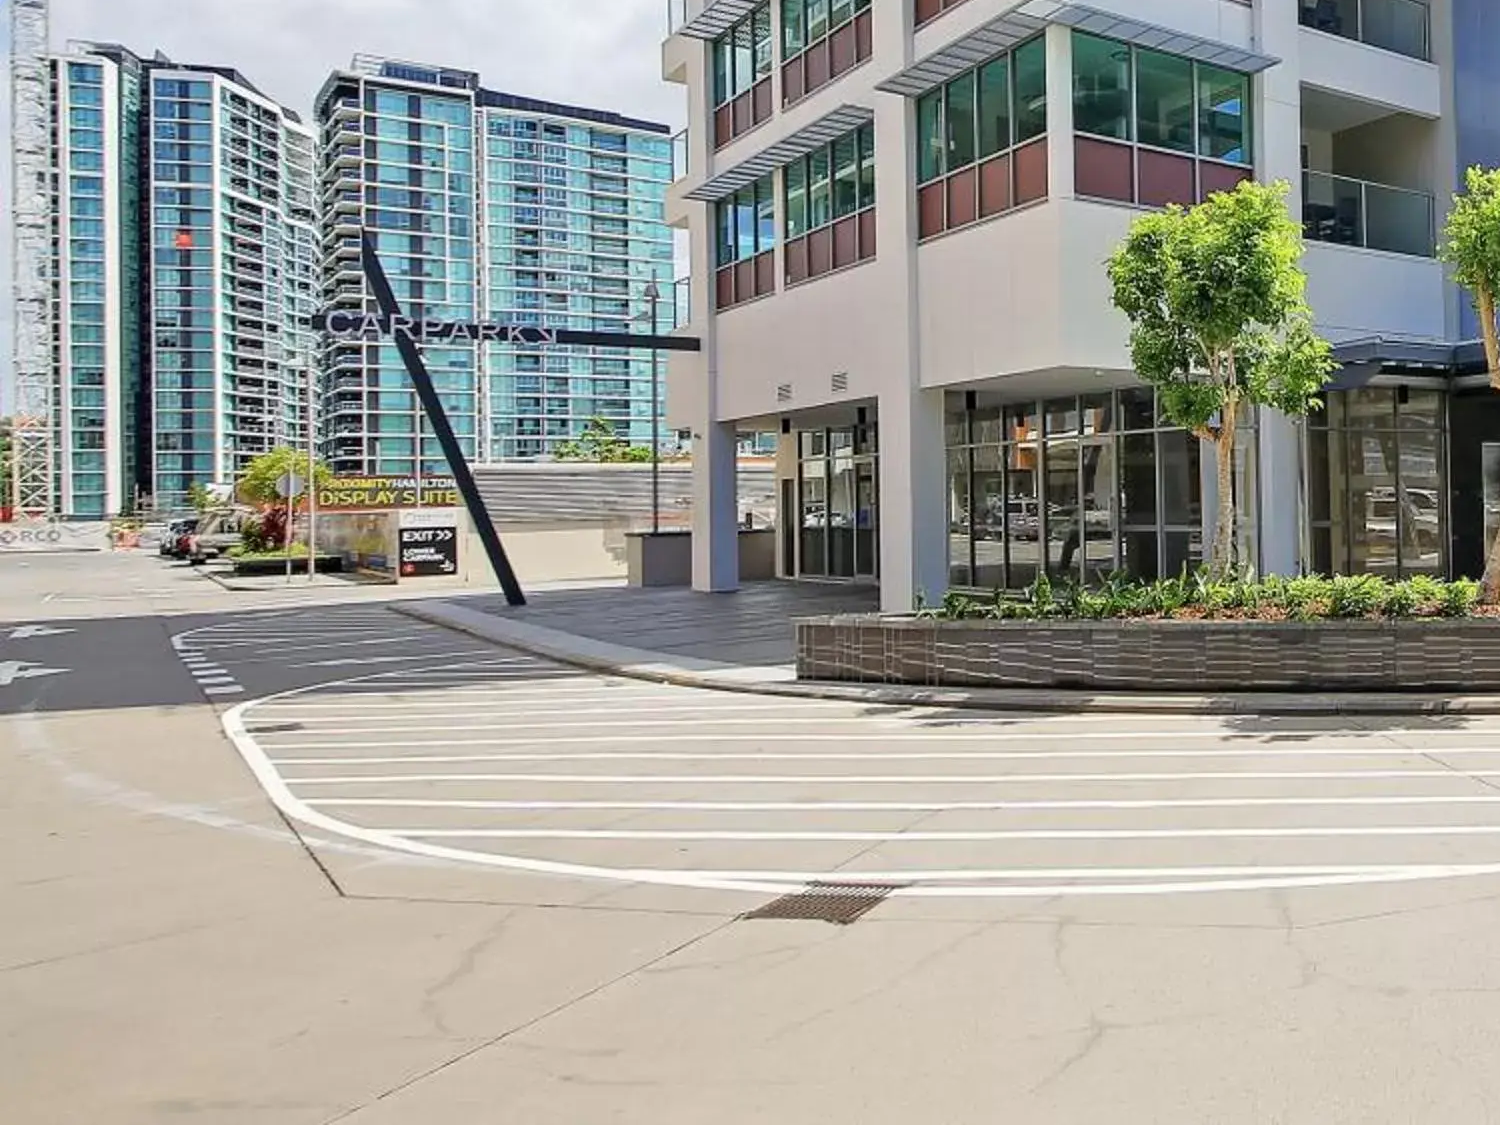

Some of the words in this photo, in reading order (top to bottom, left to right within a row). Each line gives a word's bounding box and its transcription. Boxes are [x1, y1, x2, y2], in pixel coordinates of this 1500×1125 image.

[325, 309, 527, 343] CARPARK
[402, 490, 457, 504] SUITE
[402, 530, 434, 542] EXIT
